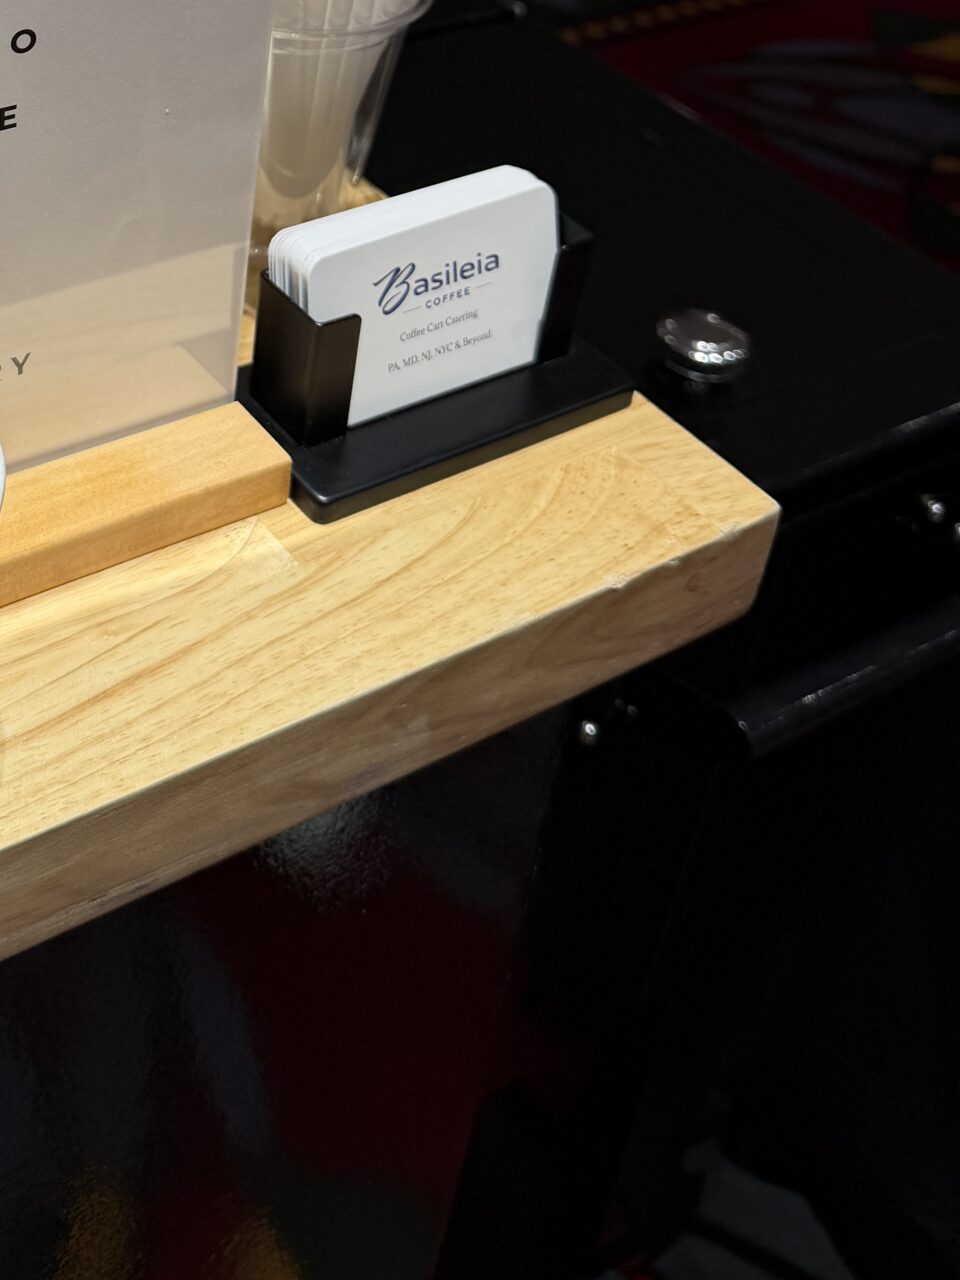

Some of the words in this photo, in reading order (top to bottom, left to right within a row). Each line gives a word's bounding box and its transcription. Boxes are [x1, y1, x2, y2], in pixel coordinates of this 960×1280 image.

[372, 252, 500, 315] Basileia
[425, 287, 471, 309] COFFEE
[400, 326, 426, 342] Coffee
[427, 320, 444, 333] Cart
[445, 309, 478, 327] Catering
[435, 341, 453, 357] NYC
[454, 339, 461, 349] &
[463, 329, 492, 348] Beyond
